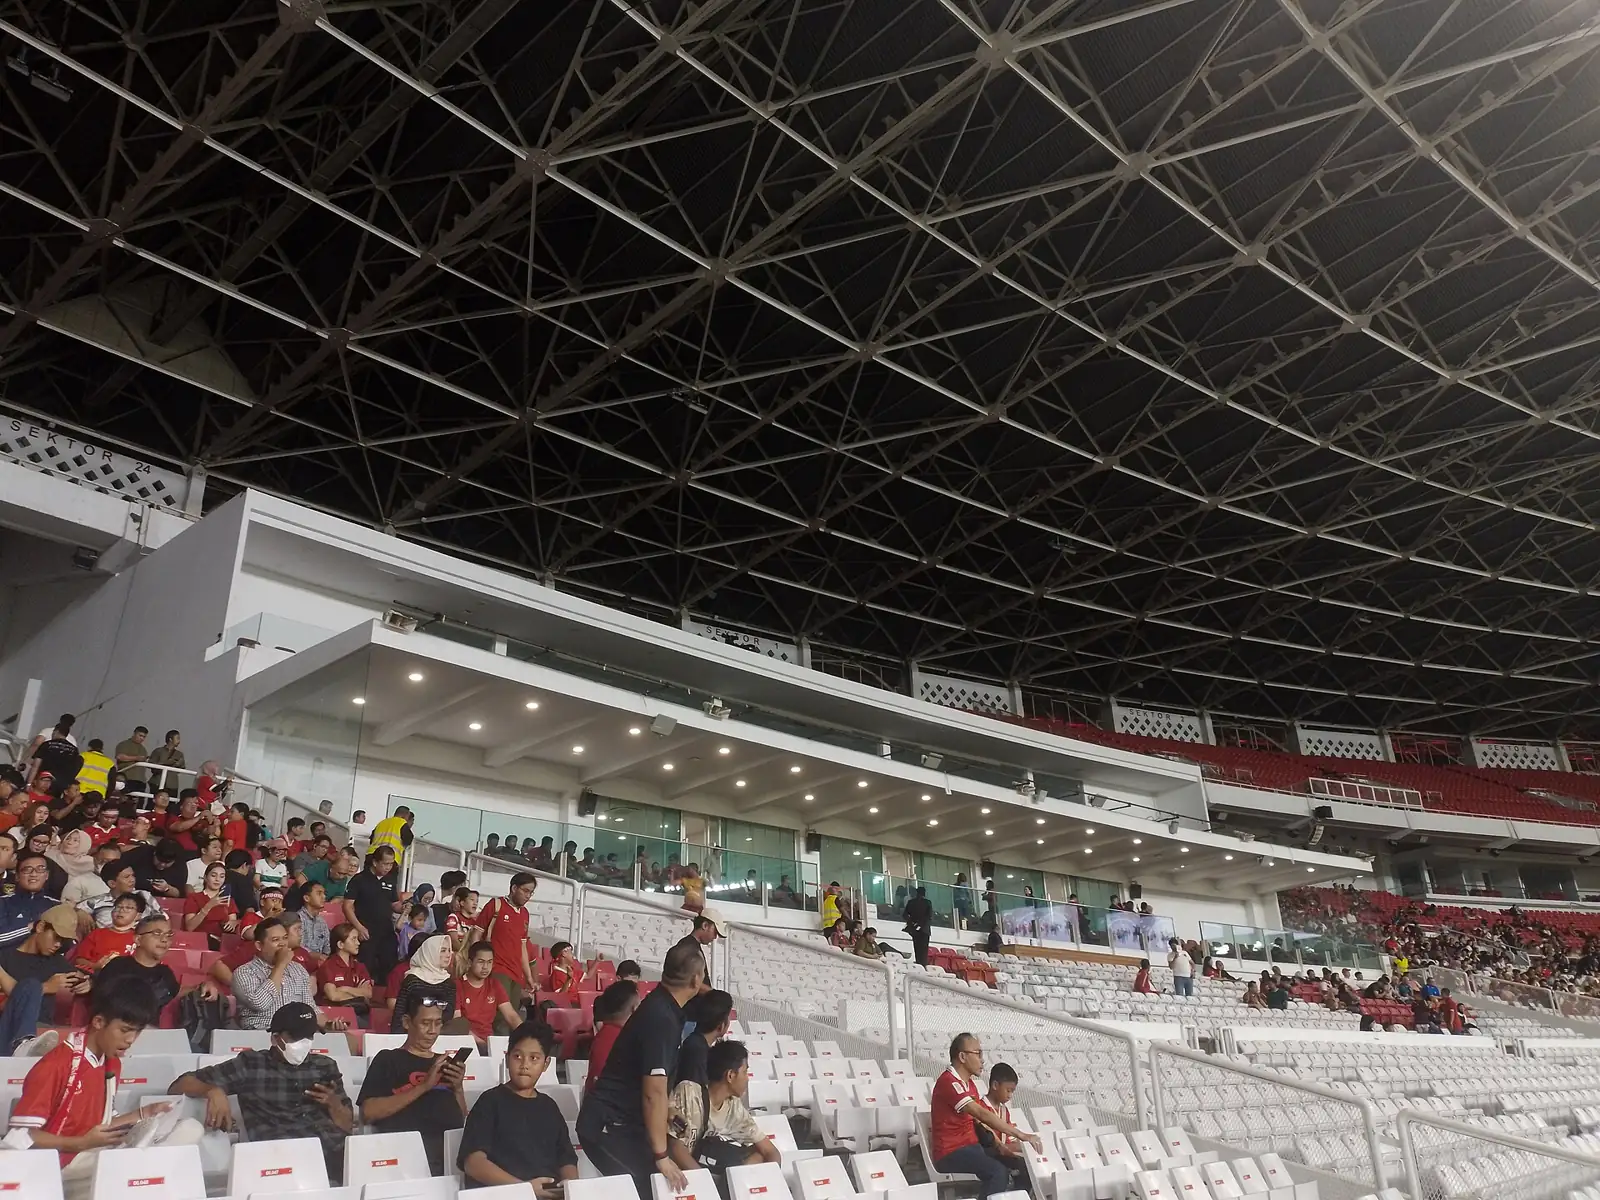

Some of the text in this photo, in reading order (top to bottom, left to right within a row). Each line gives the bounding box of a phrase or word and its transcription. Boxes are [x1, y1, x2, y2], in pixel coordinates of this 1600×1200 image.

[10, 420, 151, 475] SEKTOR 24
[1129, 708, 1171, 721] SEKTOR
